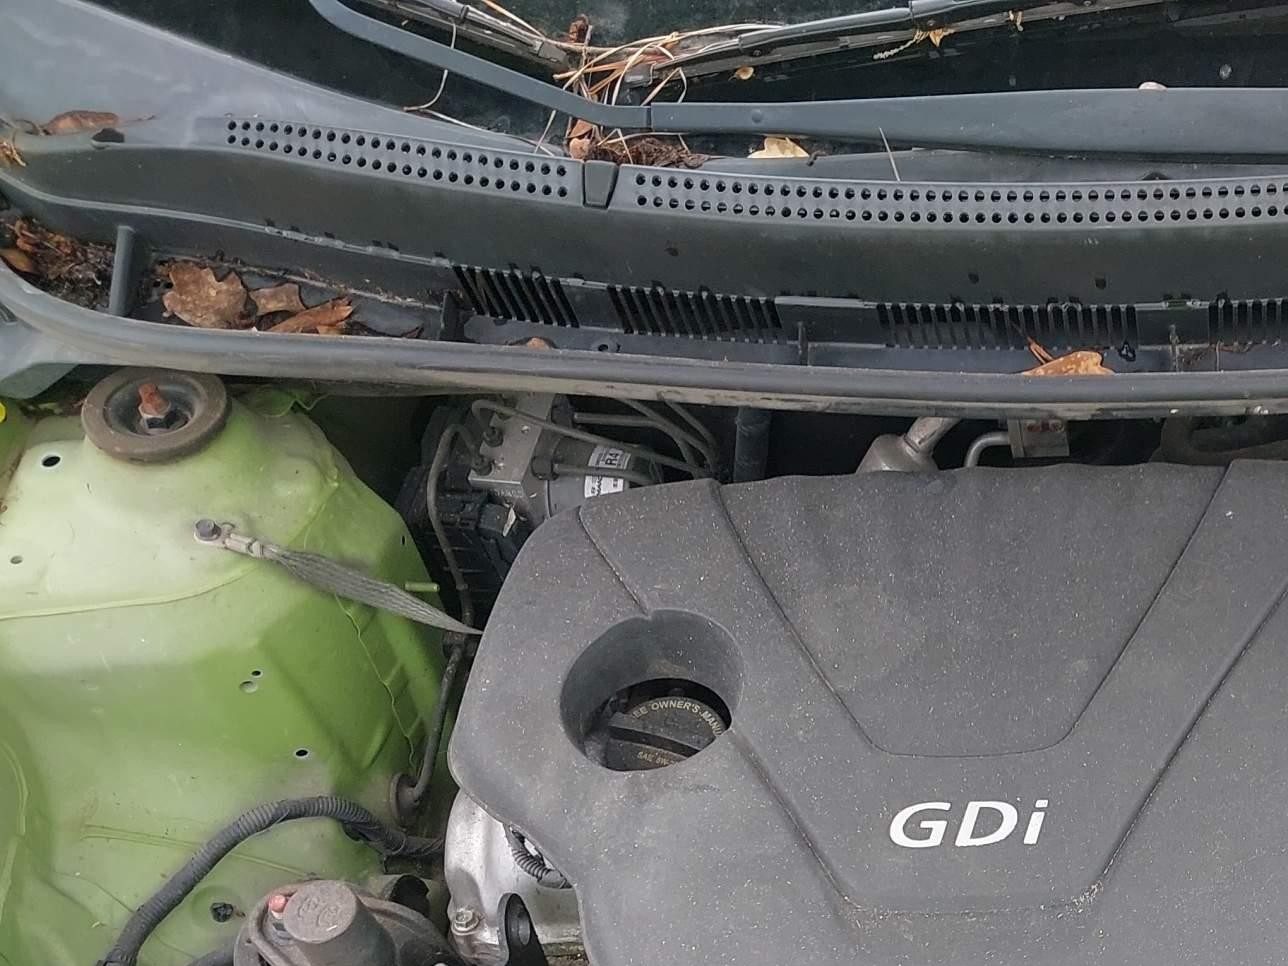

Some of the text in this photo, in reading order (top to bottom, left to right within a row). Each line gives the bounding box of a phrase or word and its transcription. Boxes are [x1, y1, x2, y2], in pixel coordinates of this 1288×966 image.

[633, 706, 649, 718] EE
[651, 701, 701, 714] OWNER'S
[889, 799, 1049, 848] GDi
